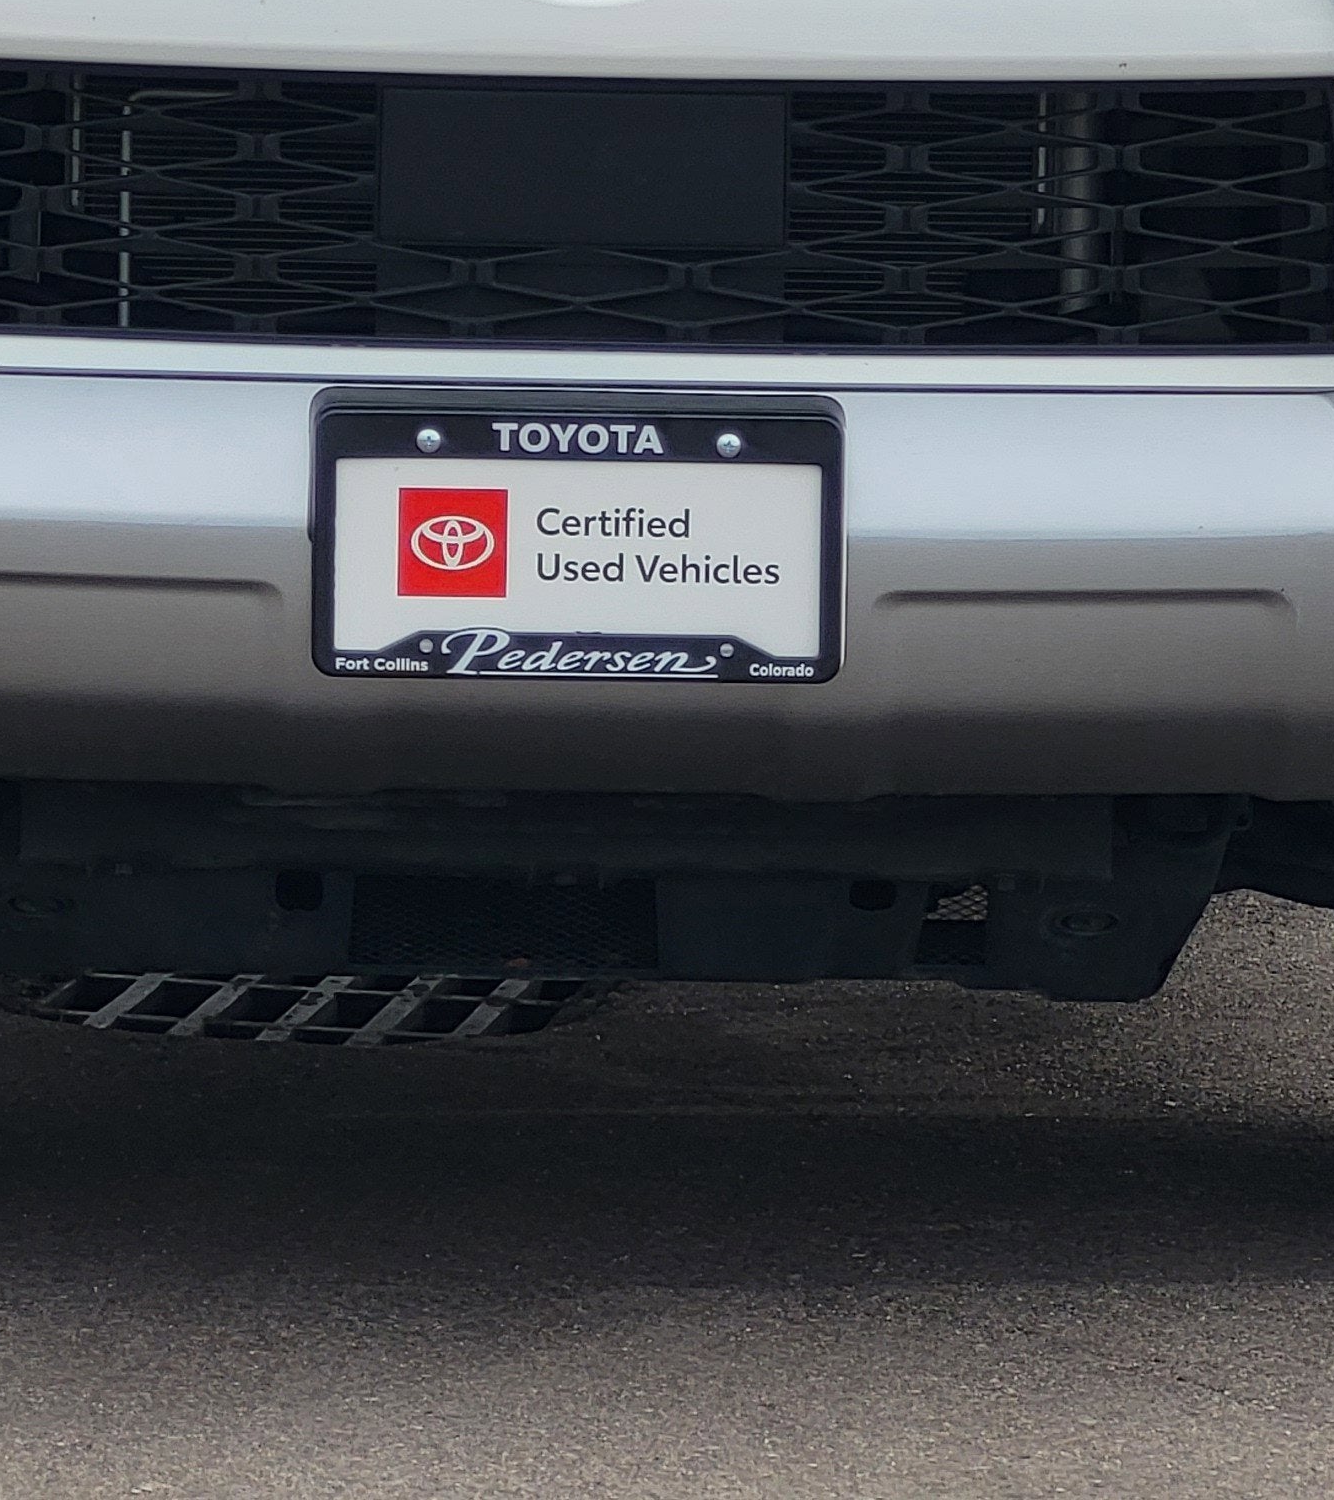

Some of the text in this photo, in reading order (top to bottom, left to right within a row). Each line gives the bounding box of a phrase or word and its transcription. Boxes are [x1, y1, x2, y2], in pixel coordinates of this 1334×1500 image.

[491, 422, 664, 455] TOYOTA
[536, 507, 691, 539] Certified
[536, 553, 781, 585] Used Vehicles
[335, 656, 429, 672] Fort Collins
[440, 628, 718, 676] Pedersen
[748, 663, 815, 678] Colorado
